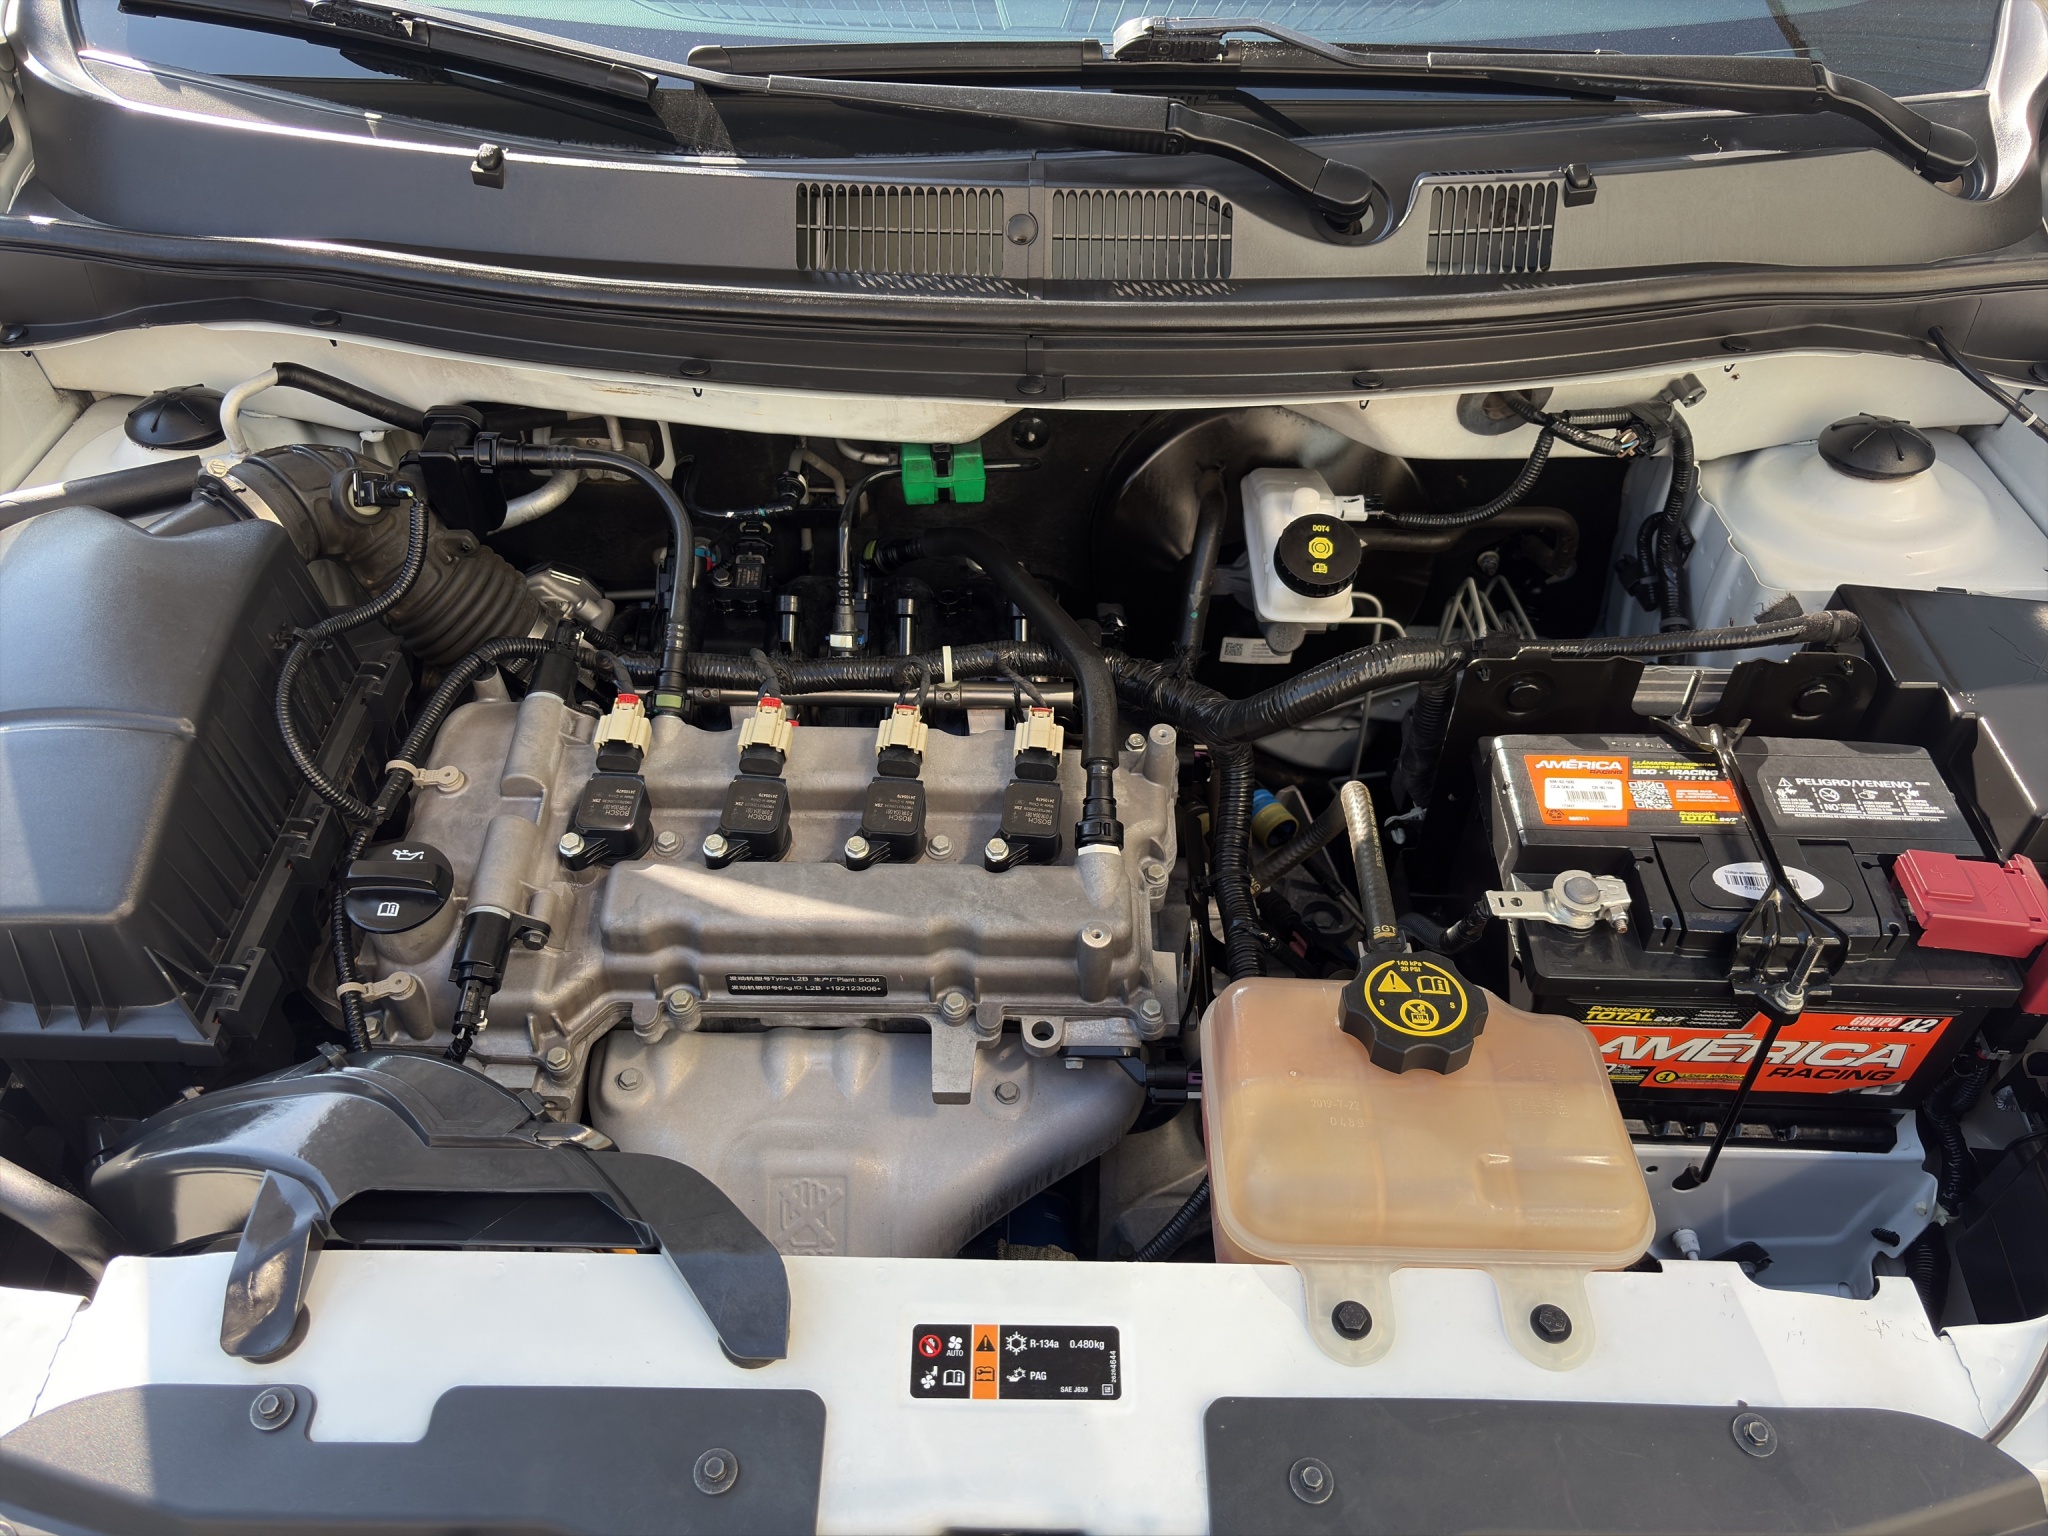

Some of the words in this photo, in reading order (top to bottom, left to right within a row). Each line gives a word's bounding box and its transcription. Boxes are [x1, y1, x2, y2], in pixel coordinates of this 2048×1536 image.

[1535, 759, 1622, 770] AMÉRICA
[1795, 777, 1912, 789] PELIGRO/VENENO
[748, 813, 772, 821] BOSCH
[1373, 925, 1397, 934] SGT
[1586, 1011, 1654, 1021] TOTAL
[1850, 1016, 1902, 1027] GRUPO
[1898, 1019, 1939, 1032] 42
[1600, 1034, 1908, 1068] AMÉRICA
[1767, 1068, 1896, 1081] RACING
[1030, 1339, 1059, 1348] R-134a
[1069, 1339, 1104, 1350] 0.480kg
[1030, 1372, 1047, 1380] PAG
